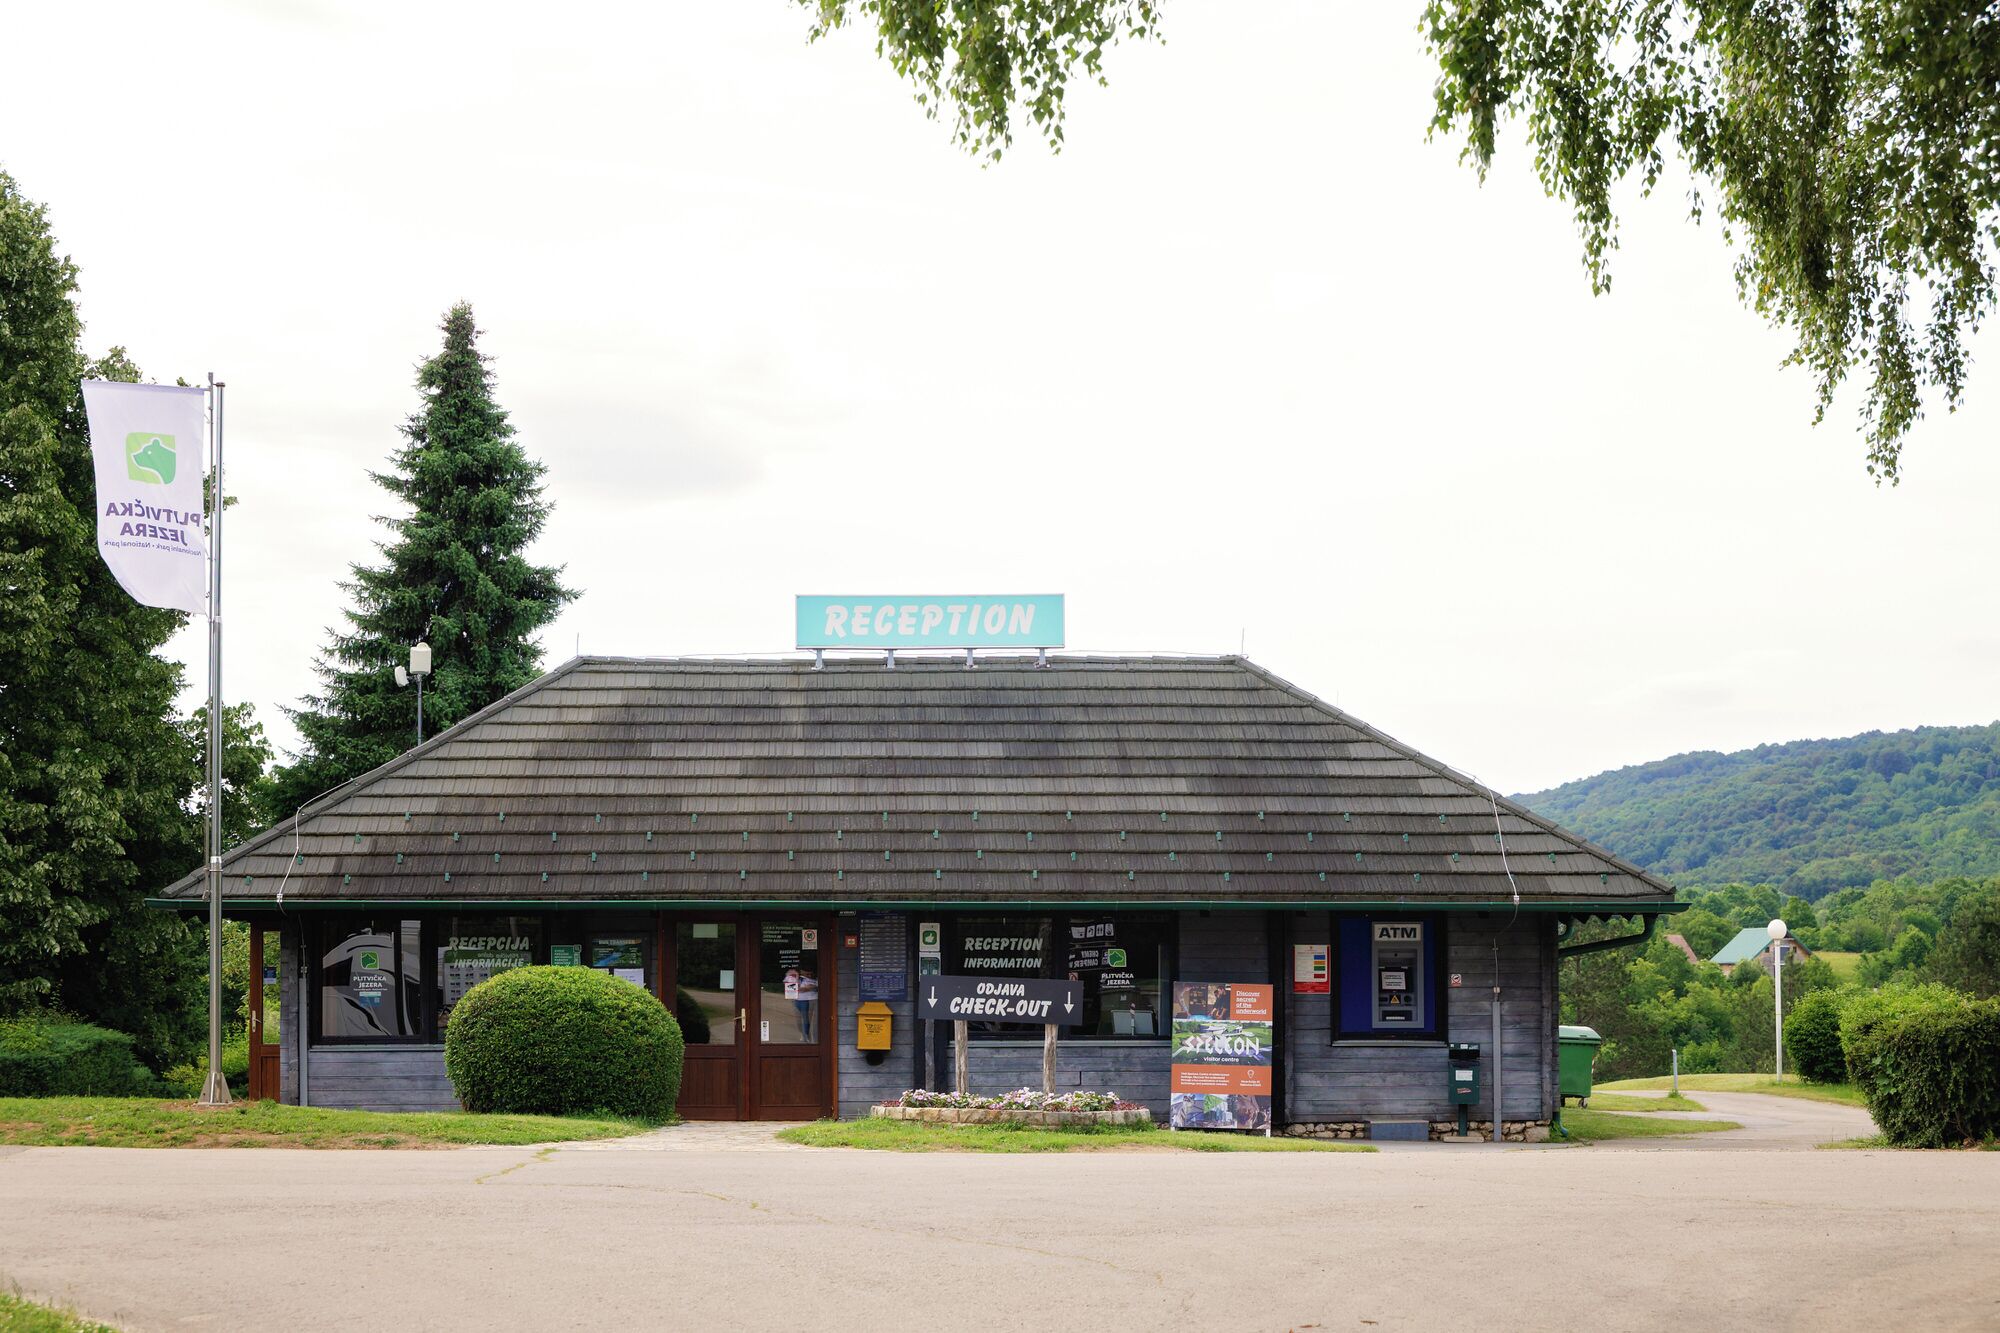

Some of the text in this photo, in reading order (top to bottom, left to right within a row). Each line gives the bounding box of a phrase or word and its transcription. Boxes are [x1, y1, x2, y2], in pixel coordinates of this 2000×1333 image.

[824, 604, 1036, 638] RECEPTION
[1379, 927, 1417, 938] ATM
[449, 936, 530, 951] RECEPCIJA
[964, 937, 1043, 951] RECEPTION
[454, 958, 524, 969] INFORMACIJE
[963, 957, 1043, 968] INFORMATION
[976, 982, 1025, 996] ODJAVA
[950, 996, 1052, 1017] CHECK-OUT
[1185, 1035, 1260, 1055] SPELEON
